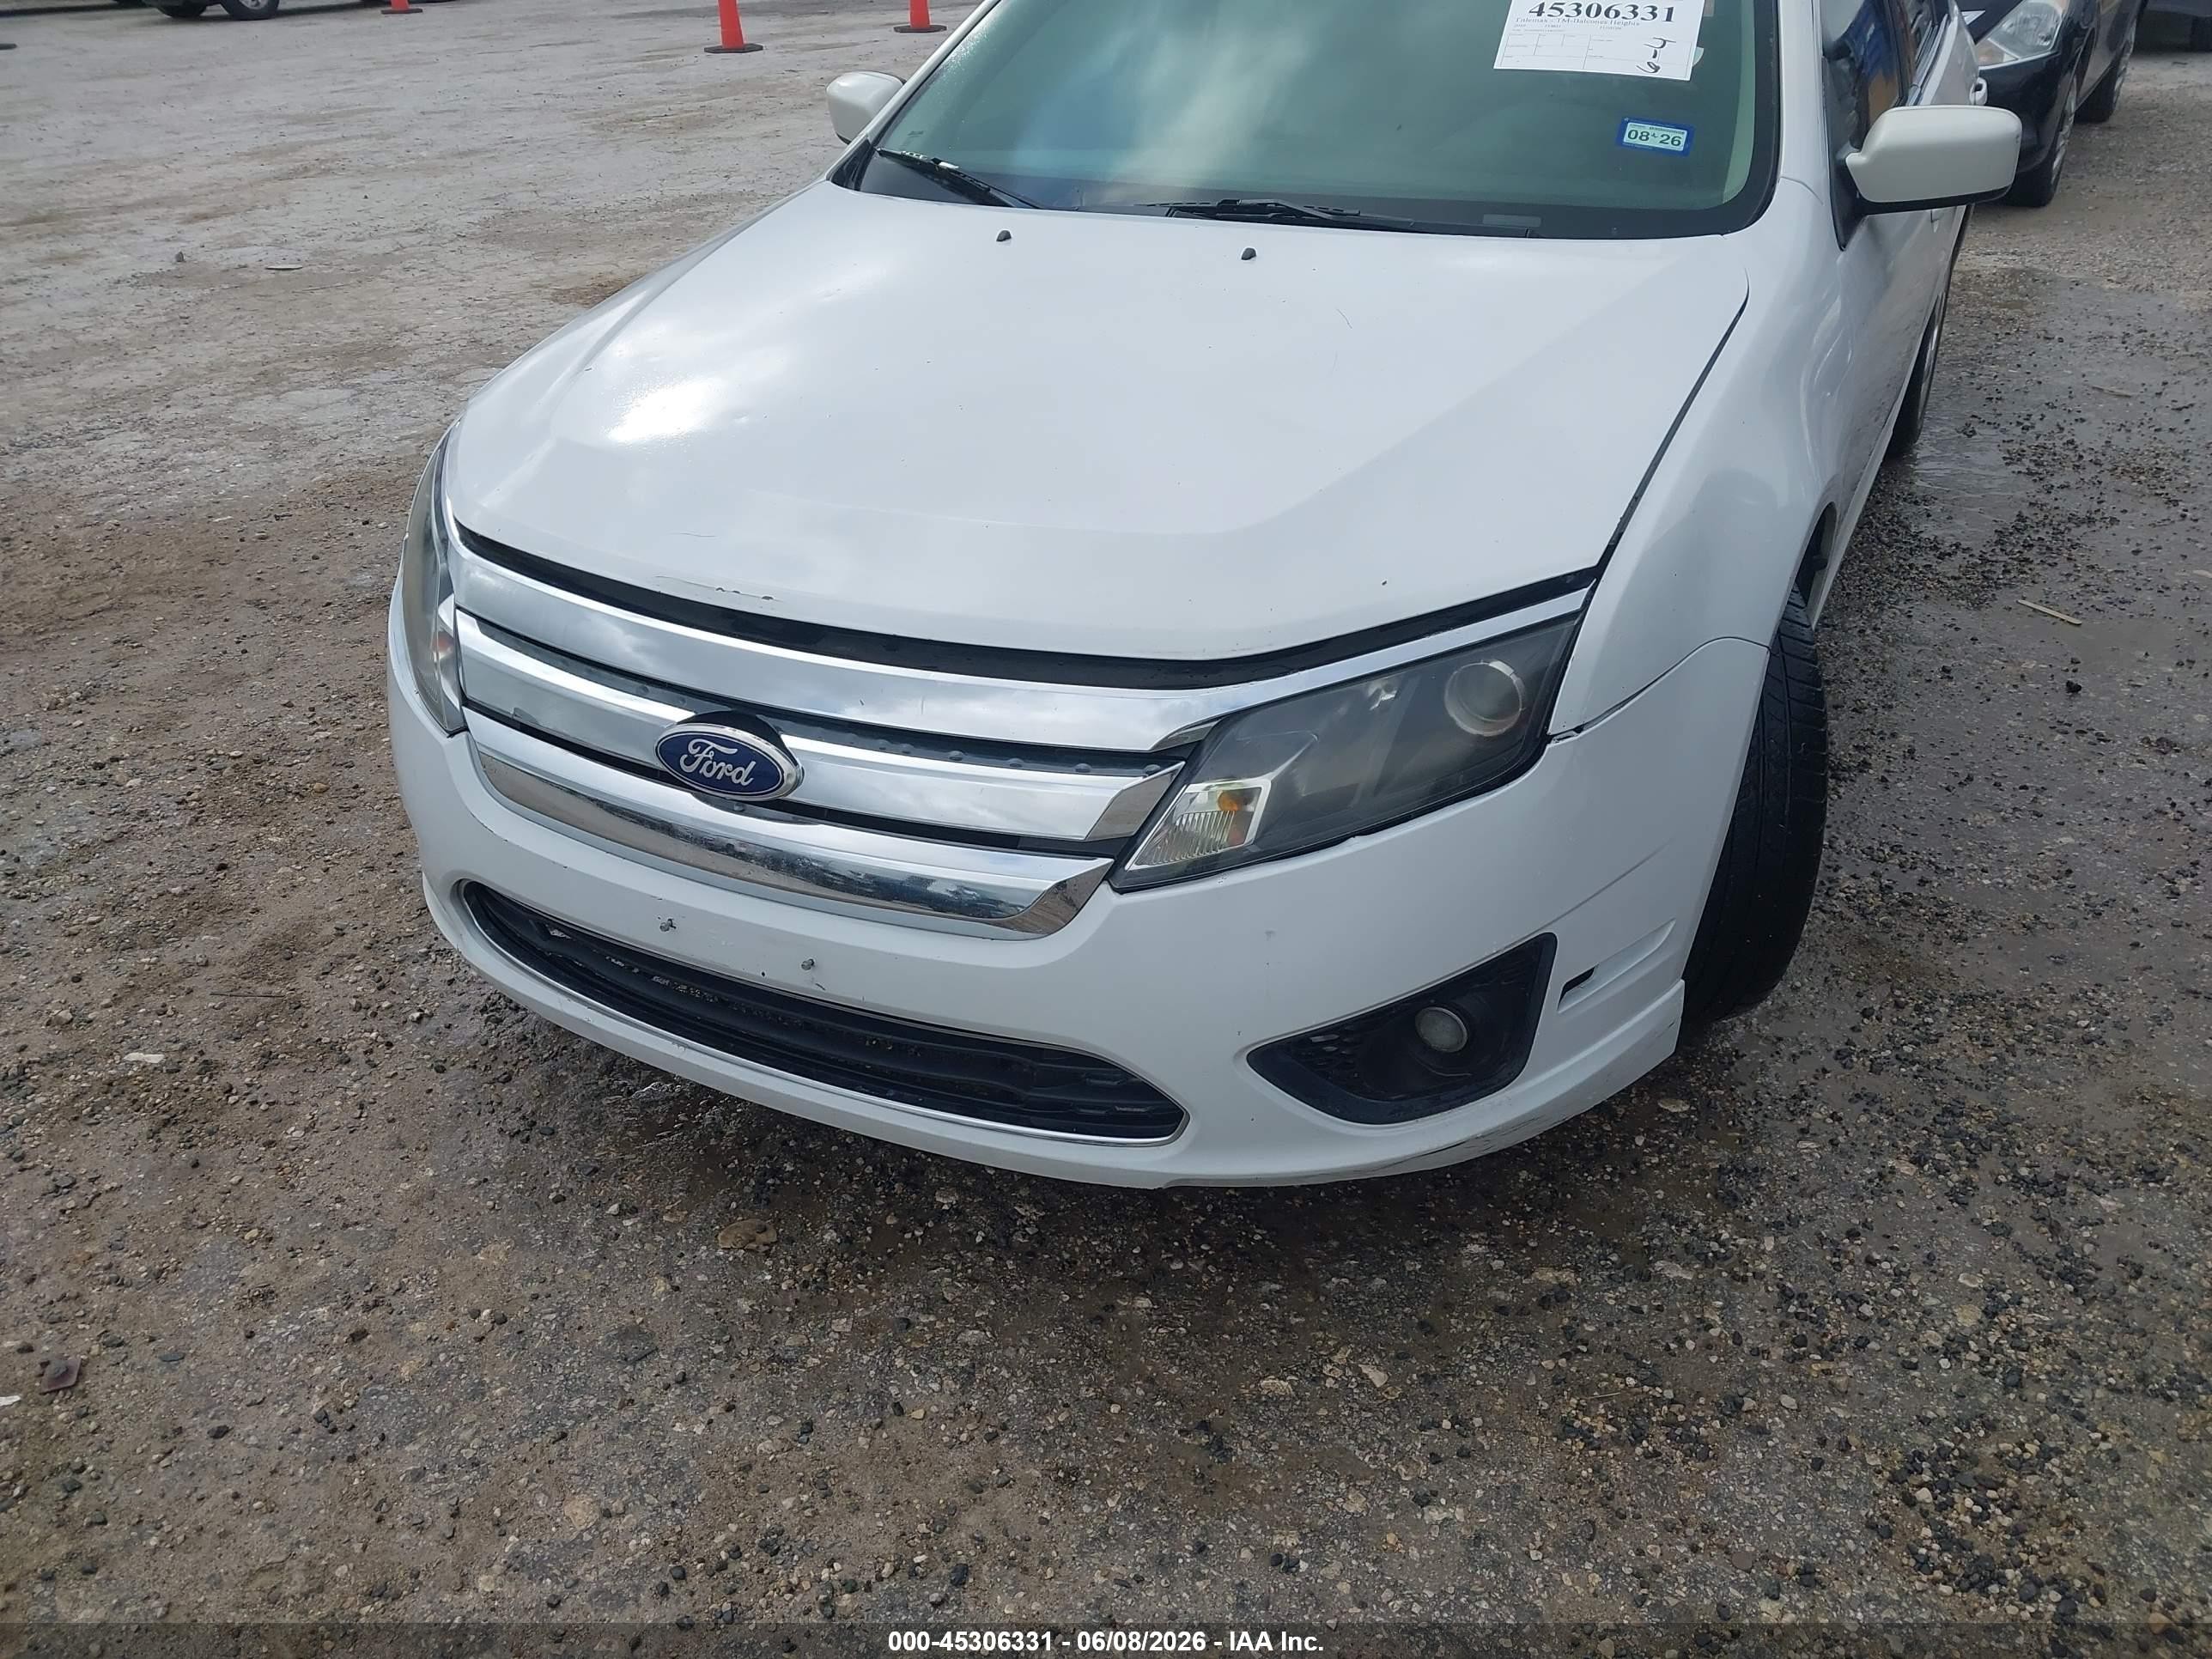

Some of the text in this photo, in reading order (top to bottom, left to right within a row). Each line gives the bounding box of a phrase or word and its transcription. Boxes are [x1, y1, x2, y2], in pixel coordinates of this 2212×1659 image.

[1528, 1, 1674, 23] 45306331
[1628, 130, 1650, 142] 08
[1658, 134, 1682, 147] 26
[679, 738, 756, 787] Ford
